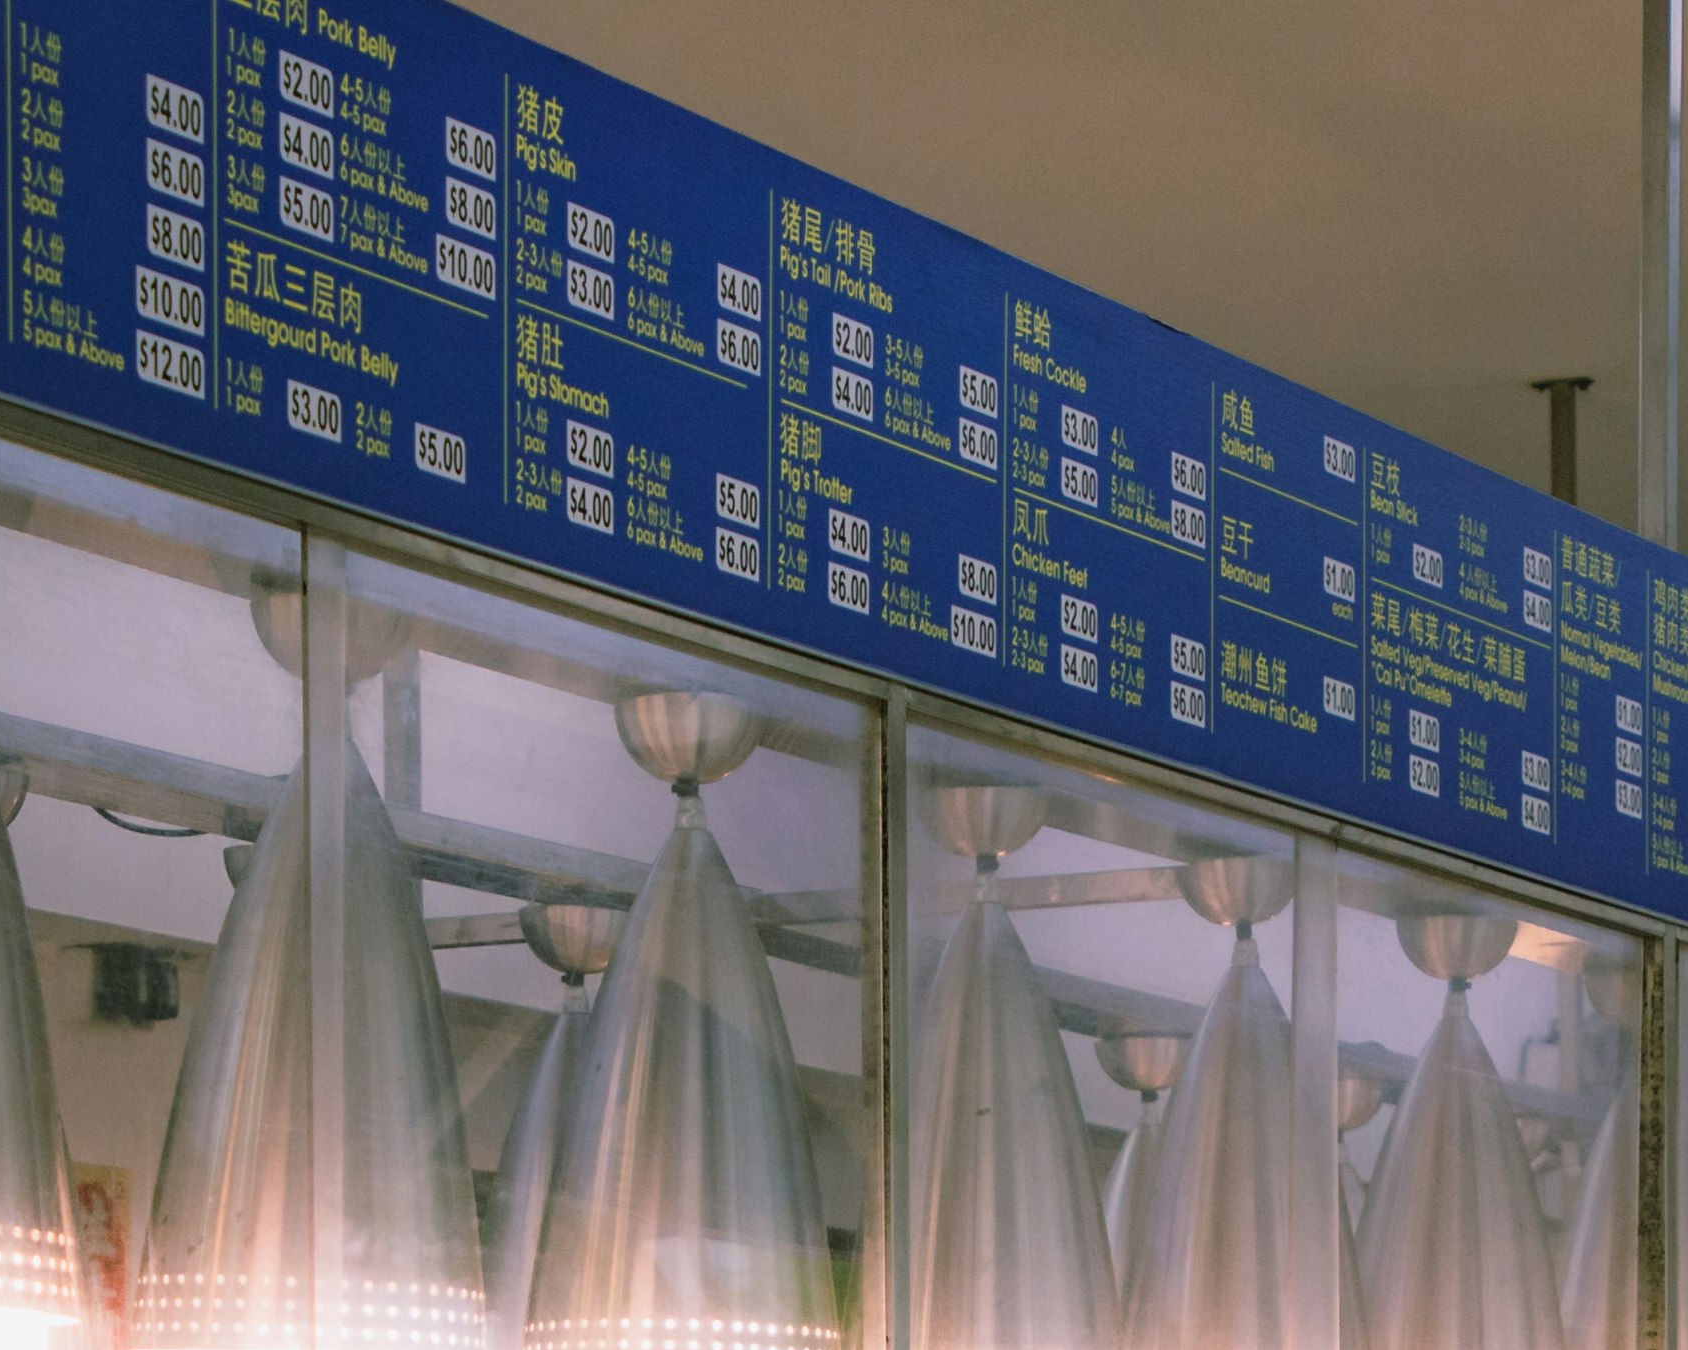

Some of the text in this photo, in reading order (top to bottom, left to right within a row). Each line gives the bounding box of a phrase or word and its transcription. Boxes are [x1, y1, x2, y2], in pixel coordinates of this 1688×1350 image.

[21, 22, 62, 65] 1人份
[229, 27, 266, 66] 1人份
[317, 8, 353, 47] Pork
[358, 28, 396, 68] Belly
[236, 64, 261, 87] pax
[284, 60, 330, 111] $2.00
[340, 74, 391, 117] 4-5人份
[21, 88, 63, 130] 2人份
[151, 85, 201, 137] $4.00
[226, 89, 265, 128] 2人份
[340, 102, 386, 135] 4-5 pax
[517, 85, 563, 144] 猪皮
[237, 126, 262, 149] pax
[284, 123, 330, 173] $4.00
[450, 126, 493, 175] $6.00
[515, 133, 576, 181] Pig's Skin
[22, 156, 64, 198] 3人份
[152, 149, 201, 200] $6.00
[226, 155, 265, 193] 3人份
[339, 135, 404, 183] 6人份以上
[284, 185, 330, 236] $5.00
[340, 196, 404, 244] 7人份以上
[450, 186, 493, 233] $8.00
[21, 226, 65, 264] 4人份
[152, 215, 201, 265] $8.00
[572, 210, 612, 257] $2.00
[780, 199, 875, 276] 猪尾/排骨
[224, 239, 363, 335] 苦瓜三层肉
[439, 242, 493, 293] $10.00
[140, 275, 201, 329] $10.00
[571, 267, 611, 314] $3.00
[721, 273, 758, 315] $4.00
[23, 290, 97, 341] 5人份以上
[224, 297, 398, 386] Bittergourd Pork Belly
[517, 315, 563, 369] 猪肚
[721, 329, 758, 370] $6.00
[836, 321, 871, 362] $2.00
[140, 339, 201, 392] $12.00
[226, 357, 263, 395] 1人份
[1013, 344, 1087, 393] Fresh Cockle
[516, 362, 609, 417] Pig's Stomach
[836, 375, 871, 415] $4.00
[963, 373, 995, 412] $5.00
[292, 388, 338, 436] $3.00
[355, 401, 393, 437] 2人份
[1064, 413, 1096, 452] $3.00
[419, 431, 463, 477] $5.00
[571, 427, 611, 472] $2.00
[780, 414, 821, 464] 猪脚
[962, 424, 995, 464] $6.00
[780, 458, 853, 503] Pig's Trotter
[1174, 458, 1204, 497] $6.00
[1327, 442, 1352, 479] $3.00
[720, 481, 757, 523] $5.00
[1065, 465, 1096, 503] $5.00
[571, 487, 611, 528] $4.00
[1013, 498, 1049, 544] 凤爪
[1174, 508, 1204, 546] $8.00
[720, 535, 757, 576] $6.00
[832, 515, 867, 556] $4.00
[962, 561, 994, 600] $8.00
[1012, 543, 1088, 588] Chicken Feet
[1326, 564, 1353, 599] $1.00
[1416, 551, 1441, 584] $2.00
[1526, 554, 1550, 586] $3.00
[832, 570, 867, 609] $6.00
[954, 614, 994, 652] $10.00
[1064, 601, 1096, 639] $2.00
[1526, 597, 1549, 629] $4.00
[1064, 652, 1096, 689] $4.00
[1174, 641, 1203, 677] $5.00
[1174, 687, 1203, 724] $6.00
[1326, 683, 1353, 717] $1.00
[1619, 701, 1639, 731] $1.00
[1412, 716, 1437, 749] $1.00
[1413, 761, 1438, 793] $2.00
[1525, 757, 1548, 788] $3.00
[1619, 743, 1639, 773] $2.00
[1525, 801, 1547, 831] $4.00
[1619, 785, 1639, 815] $3.00
